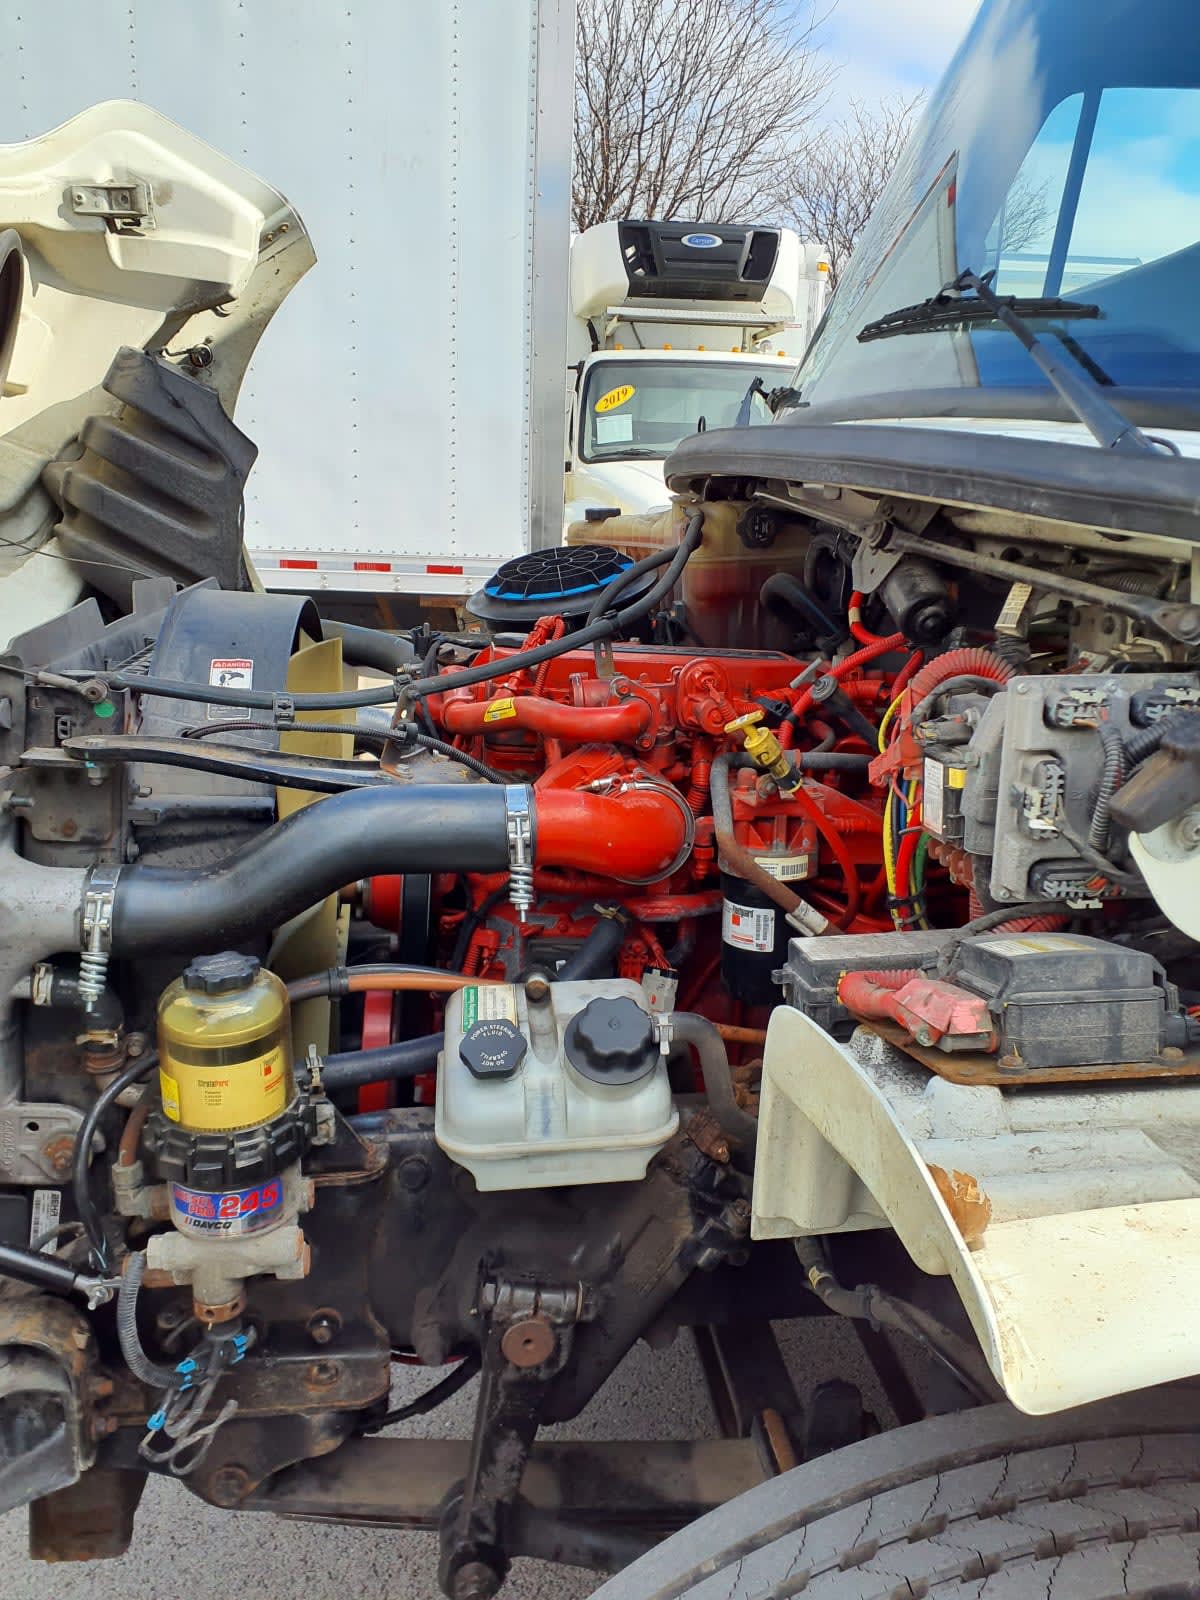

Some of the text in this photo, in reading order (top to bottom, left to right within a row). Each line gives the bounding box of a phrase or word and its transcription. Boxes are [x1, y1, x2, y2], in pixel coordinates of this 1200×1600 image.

[603, 387, 628, 409] 2019
[471, 1024, 515, 1040] POWER STEERING
[480, 1050, 508, 1060] OVERFILL
[219, 1183, 279, 1219] 245
[189, 1206, 215, 1218] PRO
[193, 1219, 233, 1230] DAYCO
